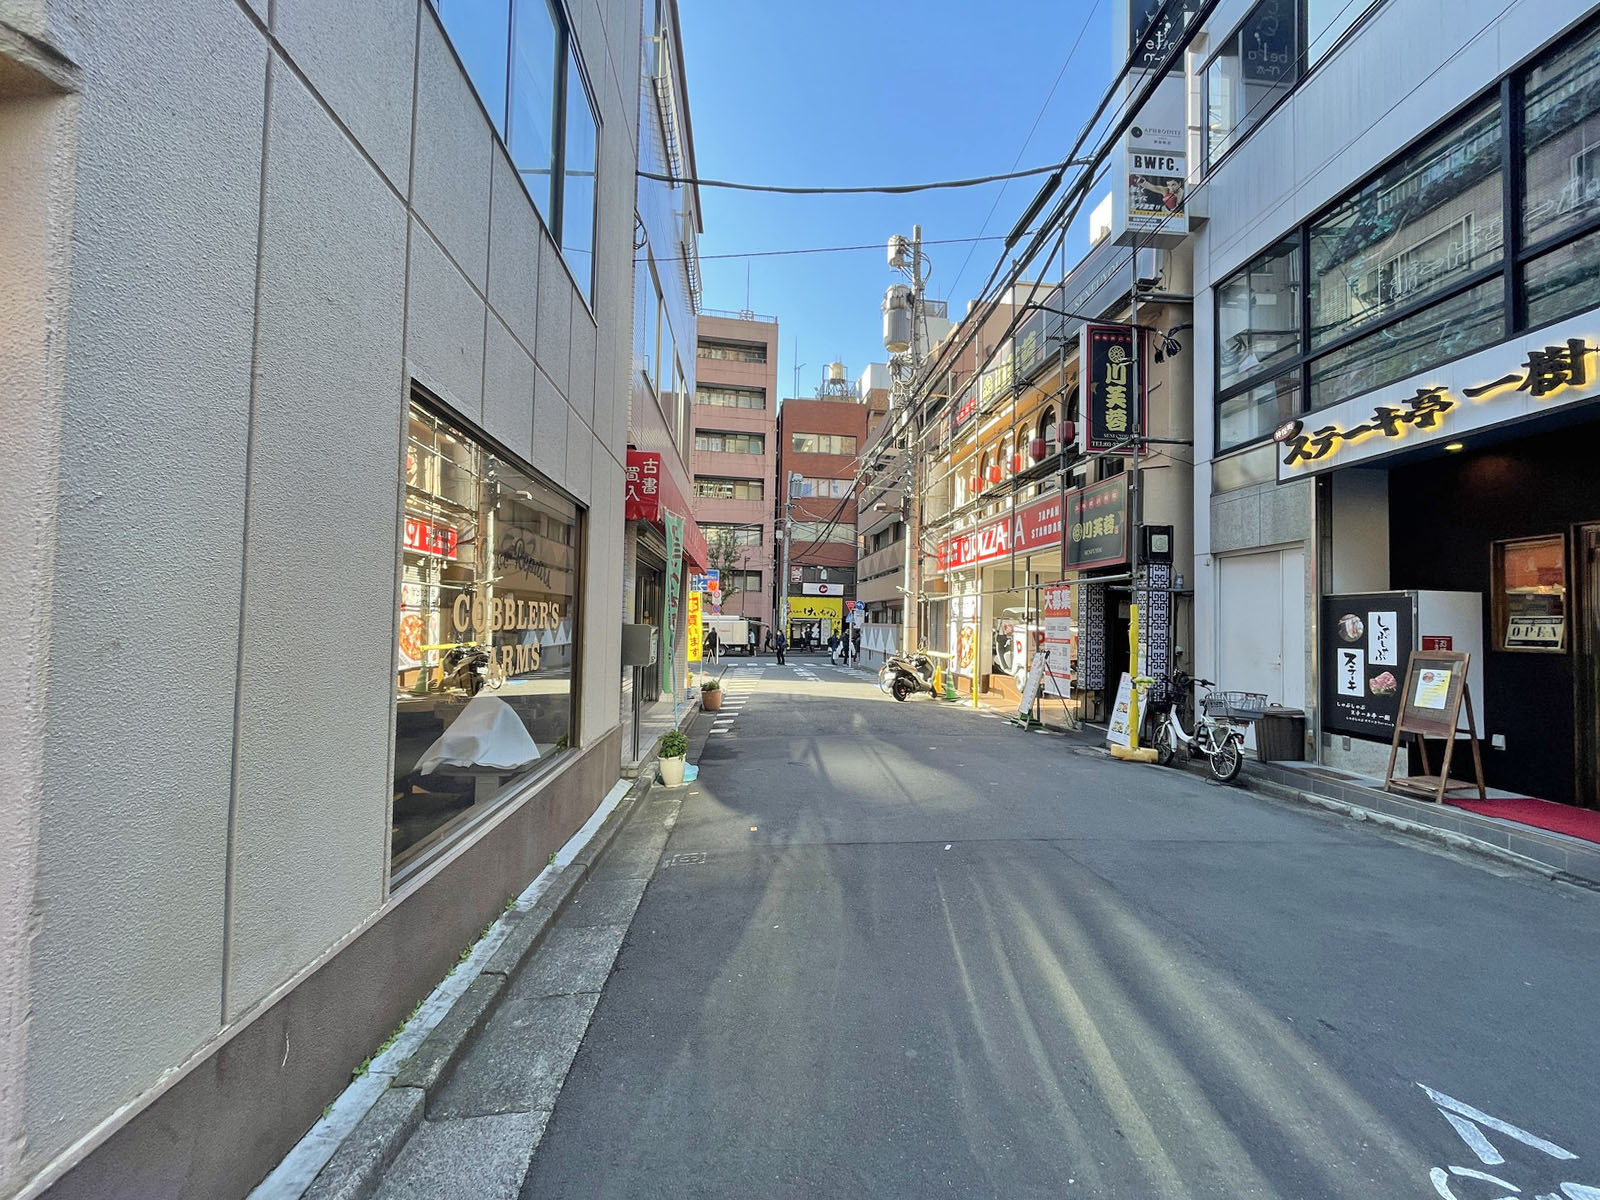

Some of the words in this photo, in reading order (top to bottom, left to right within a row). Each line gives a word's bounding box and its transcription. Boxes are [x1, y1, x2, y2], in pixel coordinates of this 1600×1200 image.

[1134, 155, 1179, 171] BWFC.
[642, 458, 659, 494] 古書
[1038, 505, 1060, 523] JAPAN
[453, 593, 560, 632] COBBLER'S
[485, 643, 541, 681] ARMS
[1343, 652, 1357, 690] ステーキ
